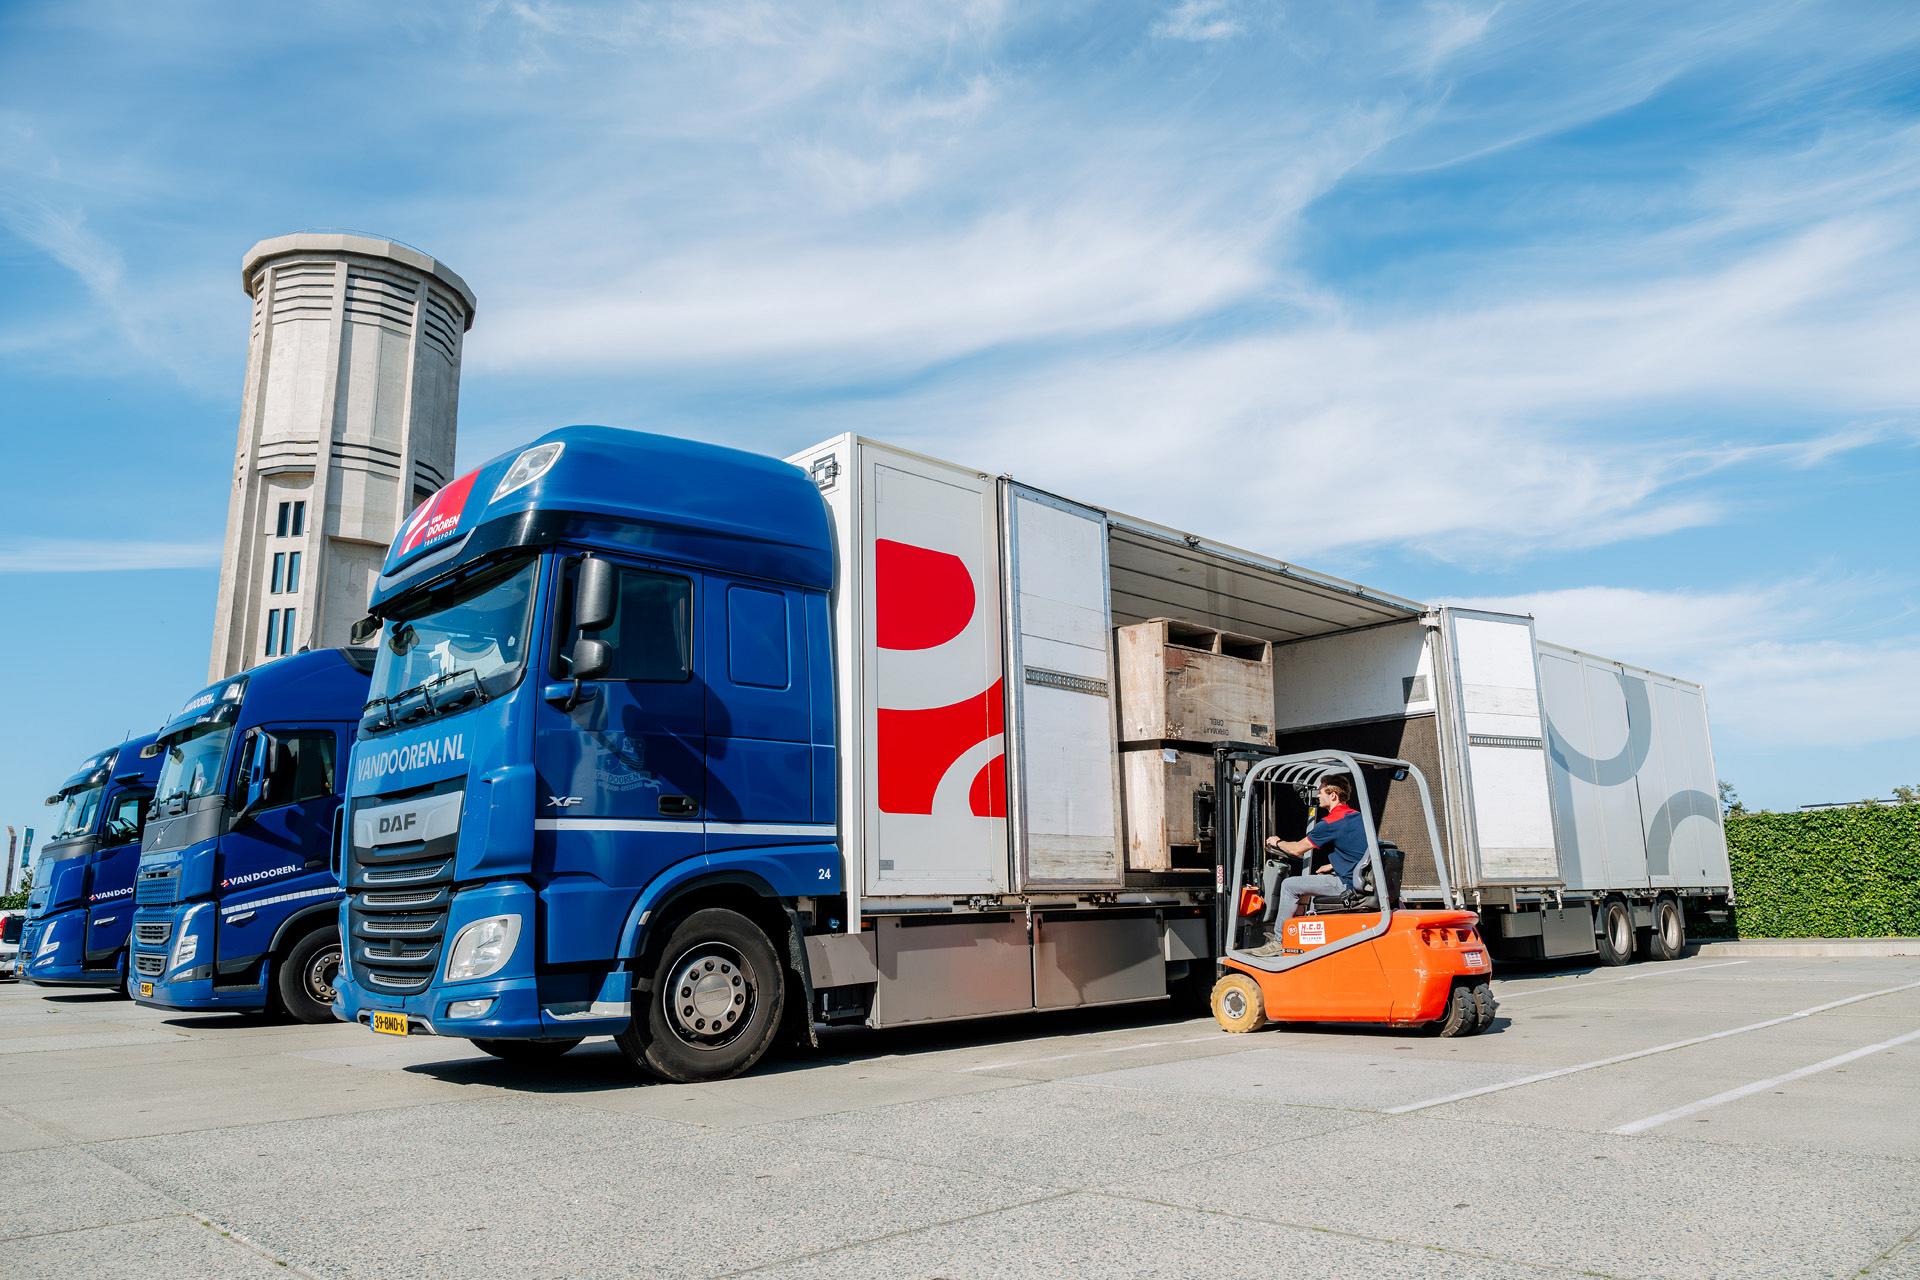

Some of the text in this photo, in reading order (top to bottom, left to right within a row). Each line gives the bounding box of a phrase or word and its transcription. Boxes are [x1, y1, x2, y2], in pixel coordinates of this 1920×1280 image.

[426, 514, 460, 538] DOOREN
[431, 514, 443, 525] VAN
[358, 734, 464, 782] VANDOOREN.NL
[546, 796, 583, 807] XF
[379, 813, 416, 834] DAF
[229, 865, 295, 885] VANDOOREN
[818, 868, 831, 880] 24
